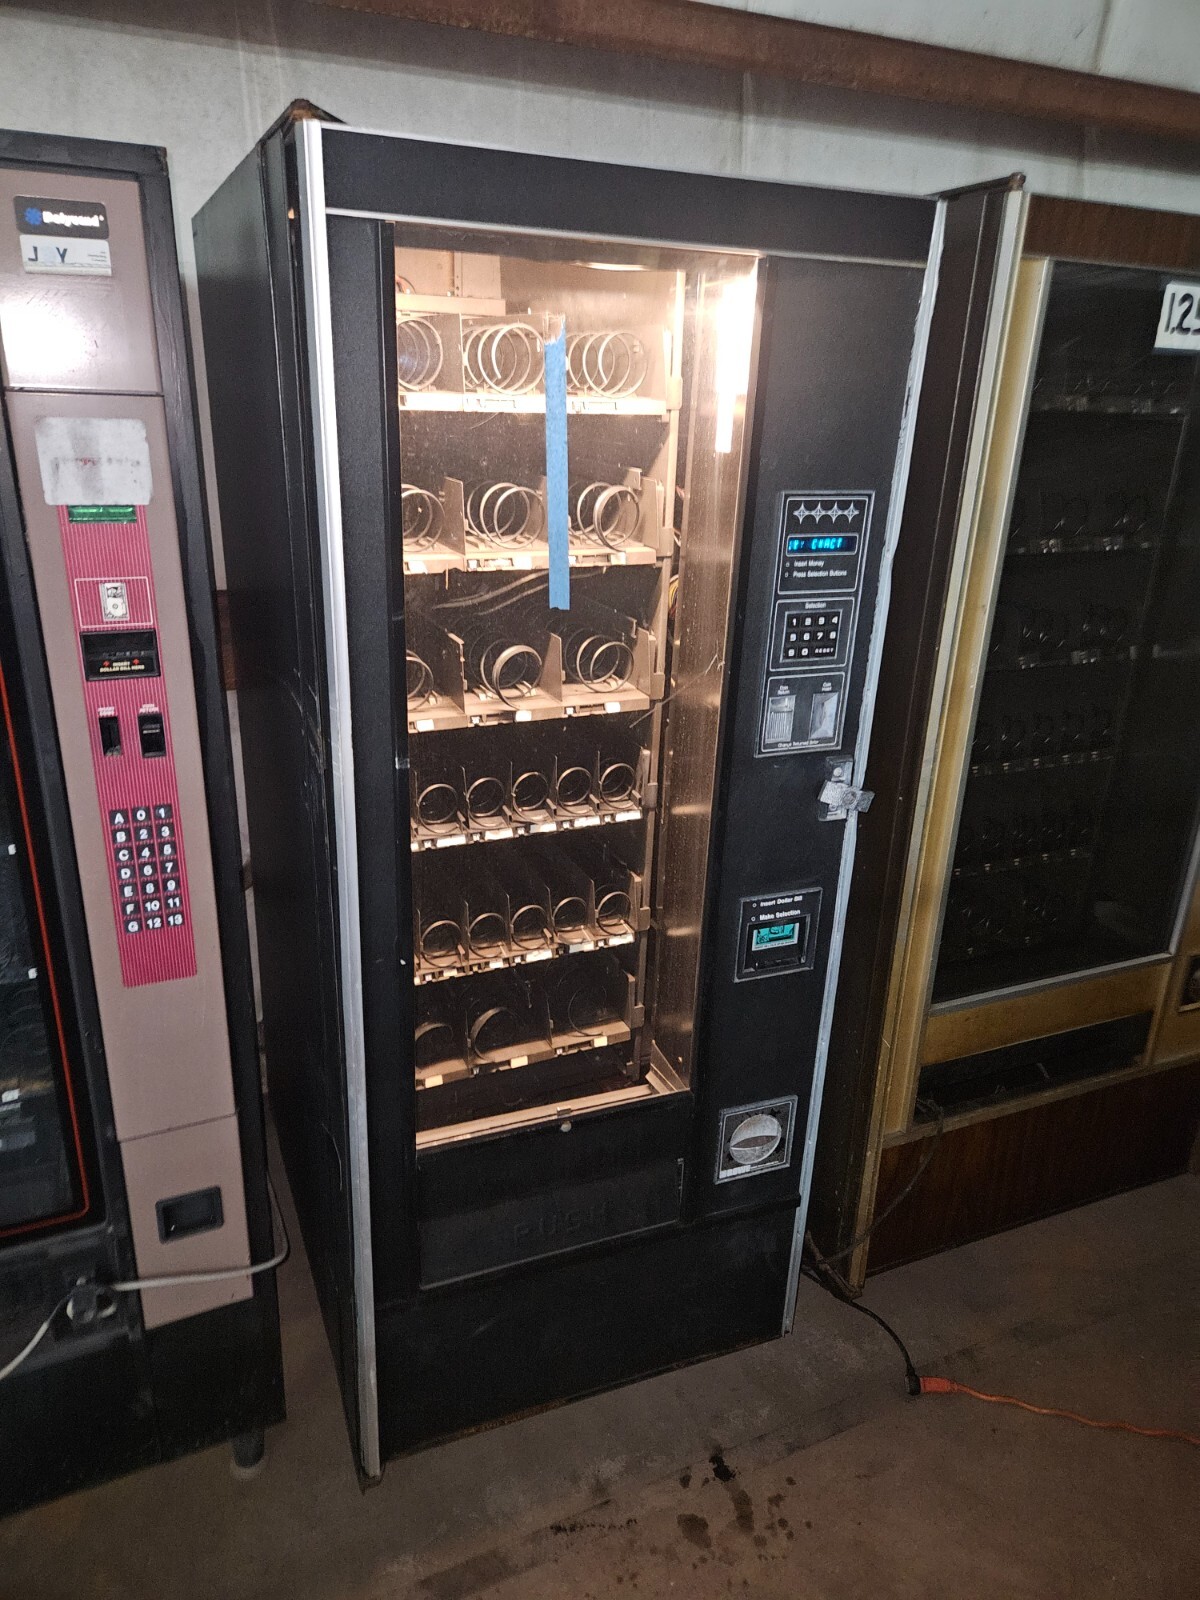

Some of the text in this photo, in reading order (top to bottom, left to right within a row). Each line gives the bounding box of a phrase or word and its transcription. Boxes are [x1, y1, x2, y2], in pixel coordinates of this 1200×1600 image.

[807, 569, 828, 577] Selection
[829, 568, 847, 577] Buttons
[808, 560, 825, 568] Money
[792, 618, 797, 626] 1
[831, 616, 838, 624] 4
[803, 632, 810, 641] 6
[817, 631, 823, 640] 7
[829, 631, 836, 639] 8
[801, 647, 808, 656] 0
[114, 807, 165, 824] A 0 1
[116, 825, 170, 843] B 2 3
[118, 844, 171, 861] C 4 5
[120, 862, 173, 879] D 6 7
[123, 880, 176, 897] E 8 9
[126, 897, 180, 915] F 10 11
[776, 909, 801, 918] Selection
[128, 914, 183, 932] G 12 13
